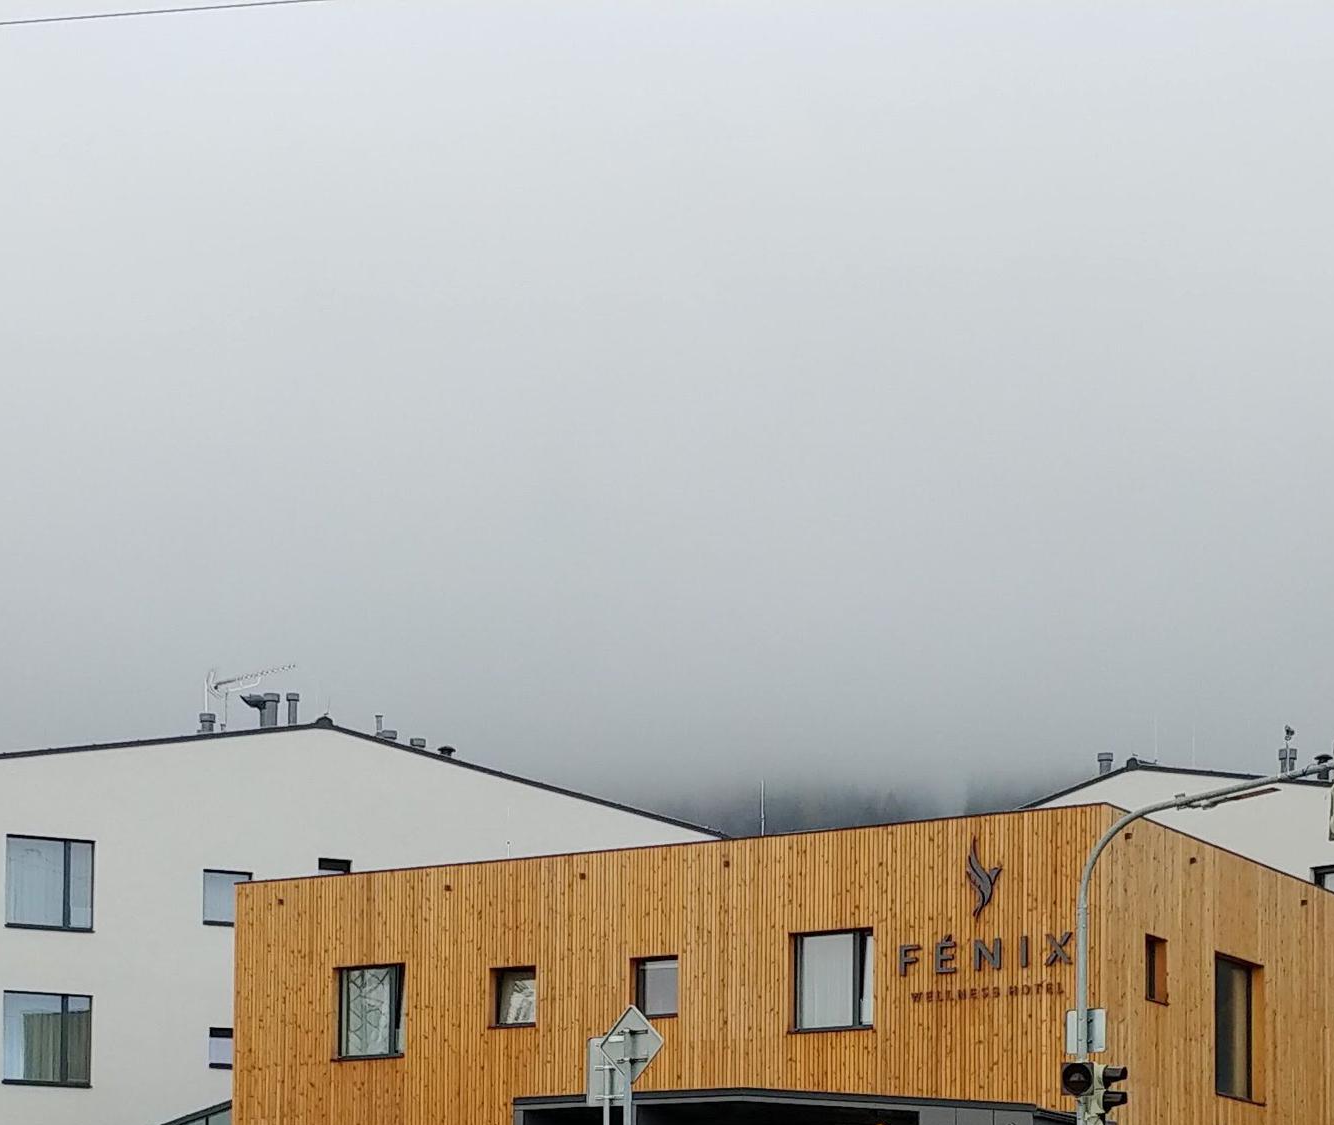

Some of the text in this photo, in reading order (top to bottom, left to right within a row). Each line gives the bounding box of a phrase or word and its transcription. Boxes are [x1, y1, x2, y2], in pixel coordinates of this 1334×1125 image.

[898, 931, 1074, 977] FÉNIX
[911, 982, 1065, 1003] WELLNESS HOTEL
